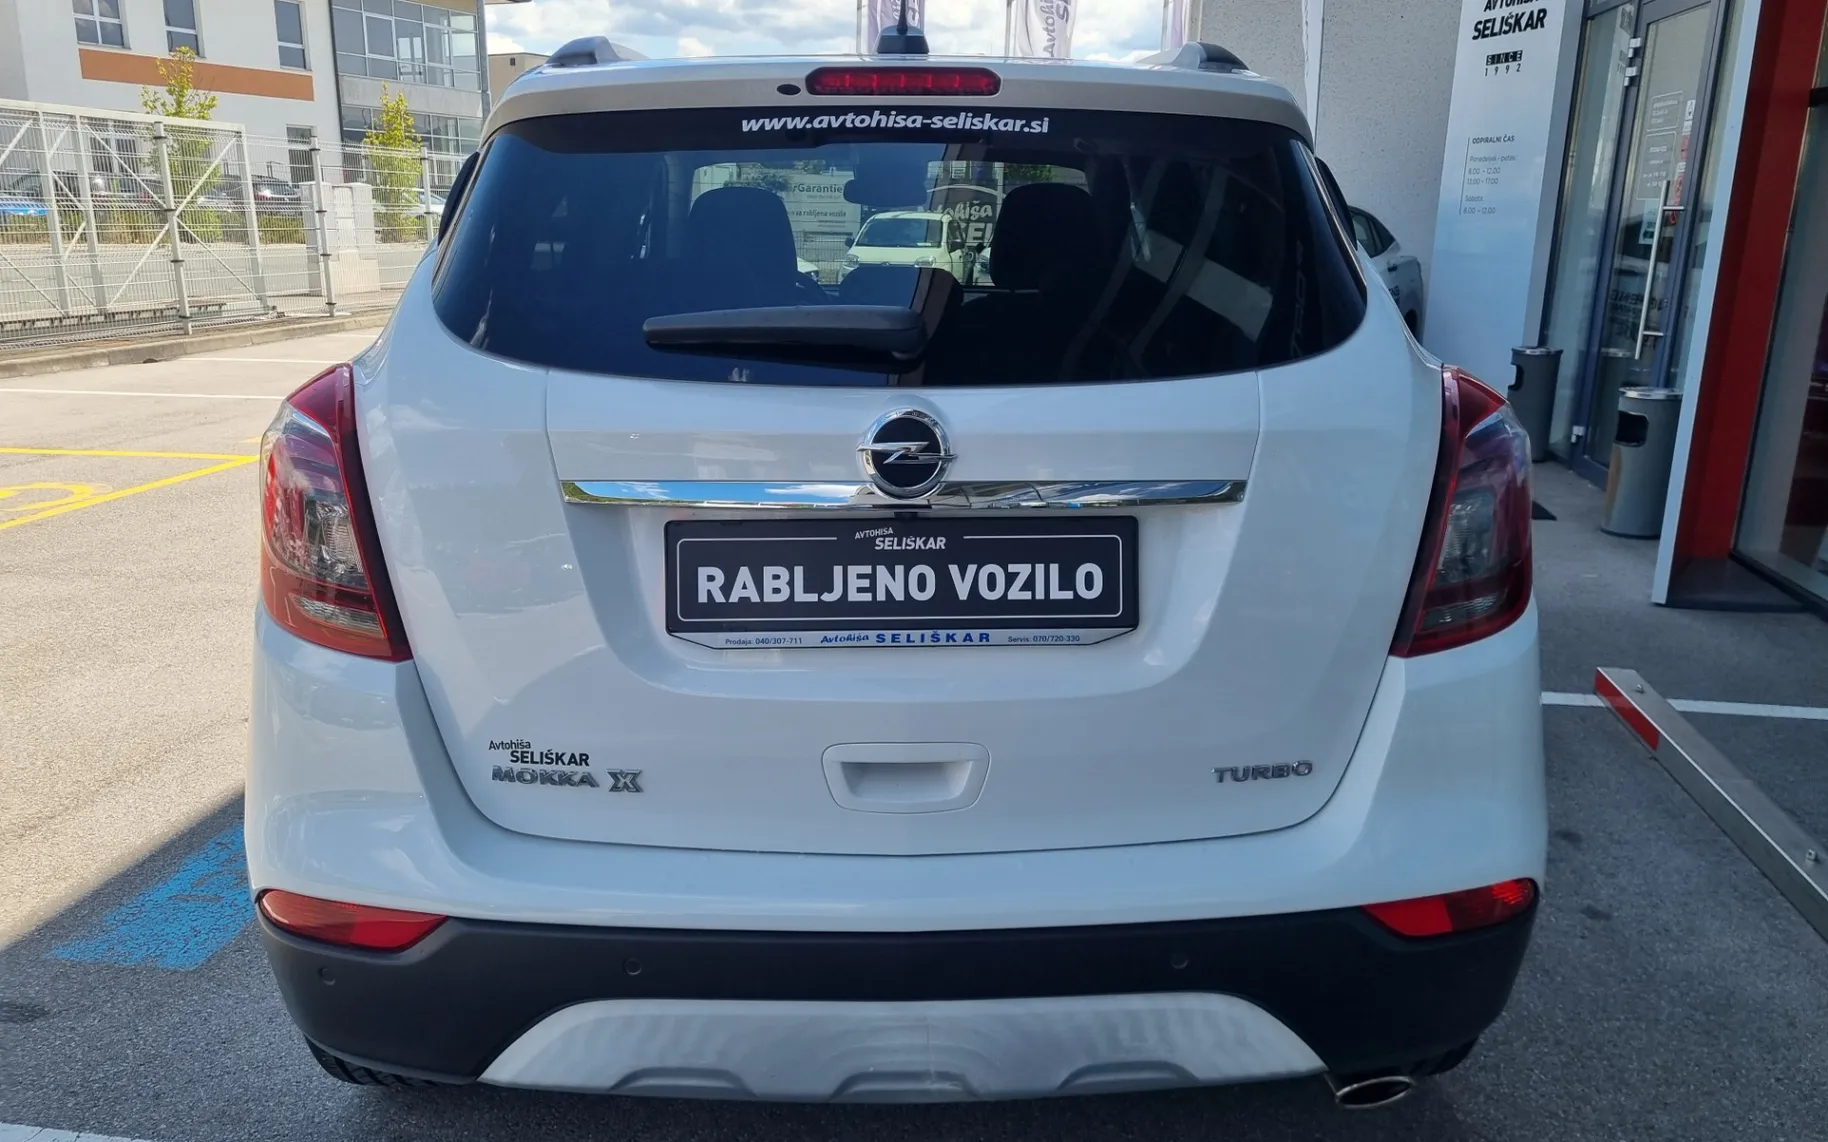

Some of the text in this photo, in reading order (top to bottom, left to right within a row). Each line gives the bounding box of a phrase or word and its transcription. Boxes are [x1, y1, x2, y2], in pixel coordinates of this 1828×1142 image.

[1471, 8, 1547, 40] SELIŠKAR
[1486, 50, 1522, 66] SINCE
[741, 110, 1049, 134] www.avtohisa-seliskar.si
[1503, 134, 1515, 142] ČAS
[875, 536, 946, 550] SELIŠKAR
[697, 563, 1103, 603] RABLJENO VOZILO
[755, 637, 802, 645] 040/307-711
[875, 631, 990, 643] SELIŠKAR
[1032, 634, 1081, 643] 070/720-330
[488, 739, 531, 750] Avtohiša
[510, 749, 590, 766] SELIŠKAR
[491, 766, 644, 793] MOKKA X
[1210, 760, 1313, 783] TURBO
